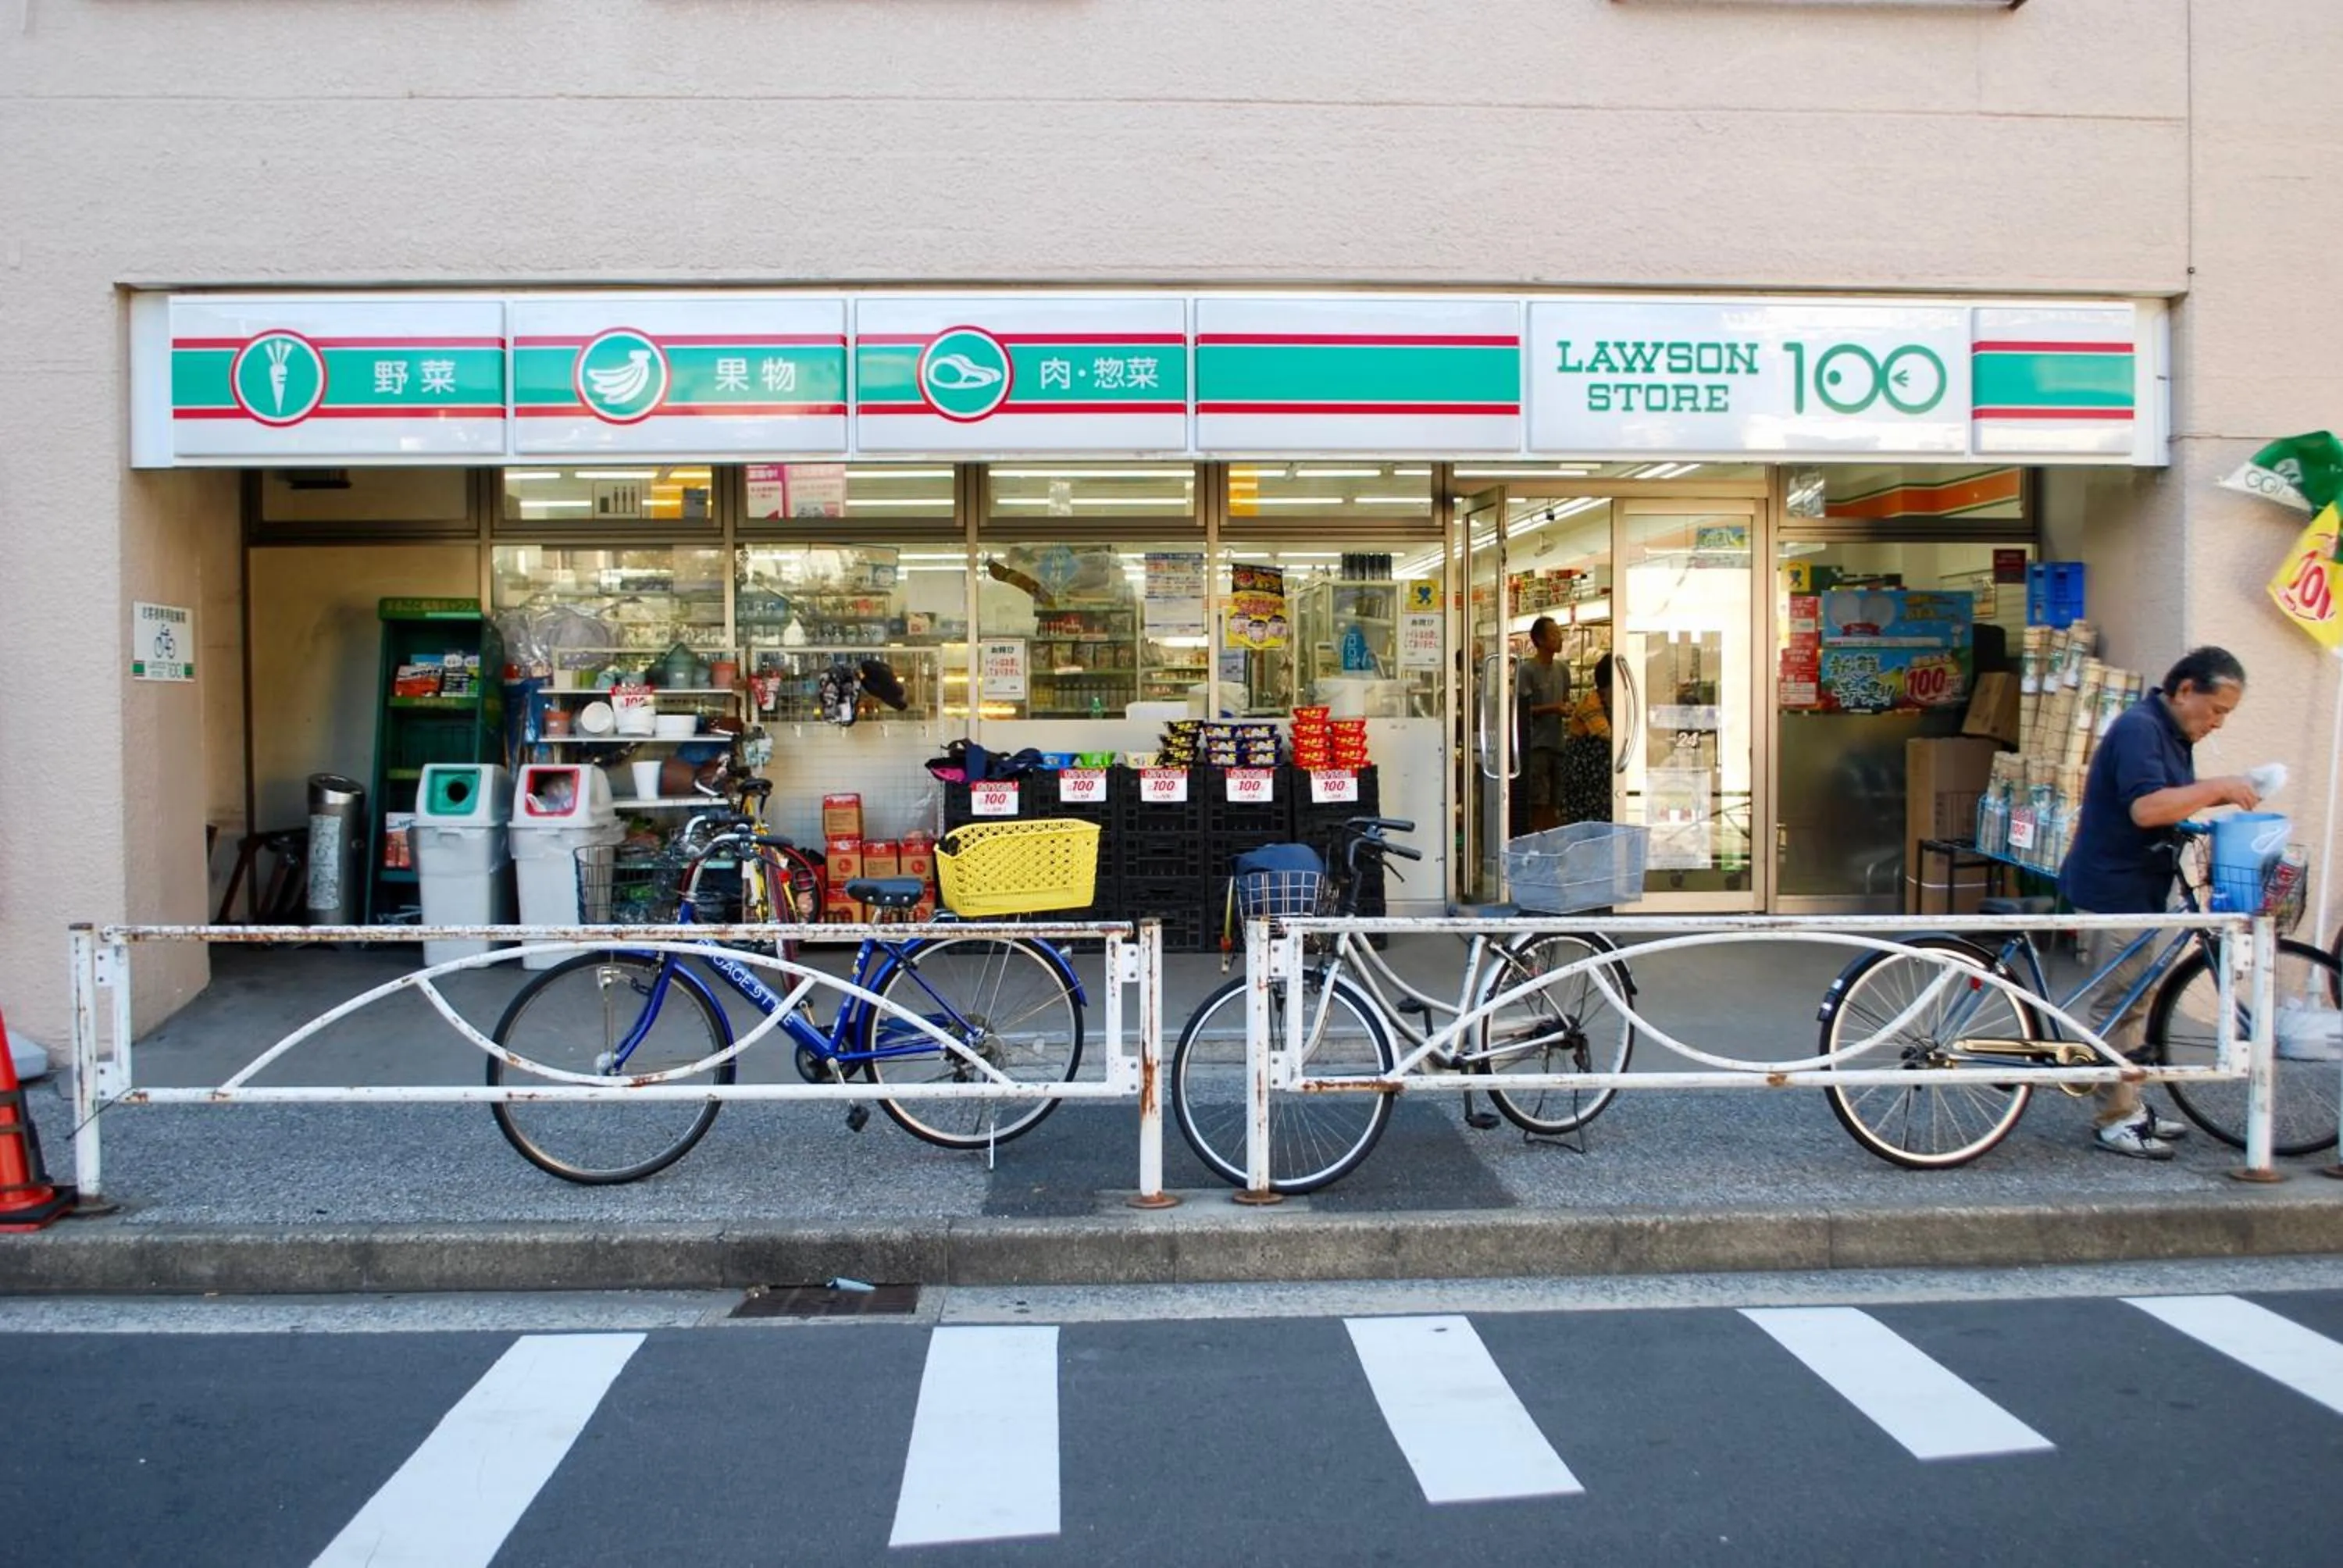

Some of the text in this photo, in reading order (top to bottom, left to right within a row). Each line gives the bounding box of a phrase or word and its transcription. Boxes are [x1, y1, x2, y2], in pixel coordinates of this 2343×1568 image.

[1557, 340, 1759, 376] LAWSON
[373, 359, 457, 394] 野菜
[715, 358, 796, 392] 果物
[1040, 356, 1160, 390] 肉・惣菜
[1782, 342, 1948, 415] 100
[1587, 383, 1729, 412] STORE
[1675, 732, 1699, 747] 24
[985, 793, 1007, 805] 100
[1072, 780, 1094, 791] 100
[1154, 780, 1175, 791] 100
[1239, 780, 1261, 791] 100
[1324, 780, 1346, 791] 100
[749, 985, 793, 1027] STYE
